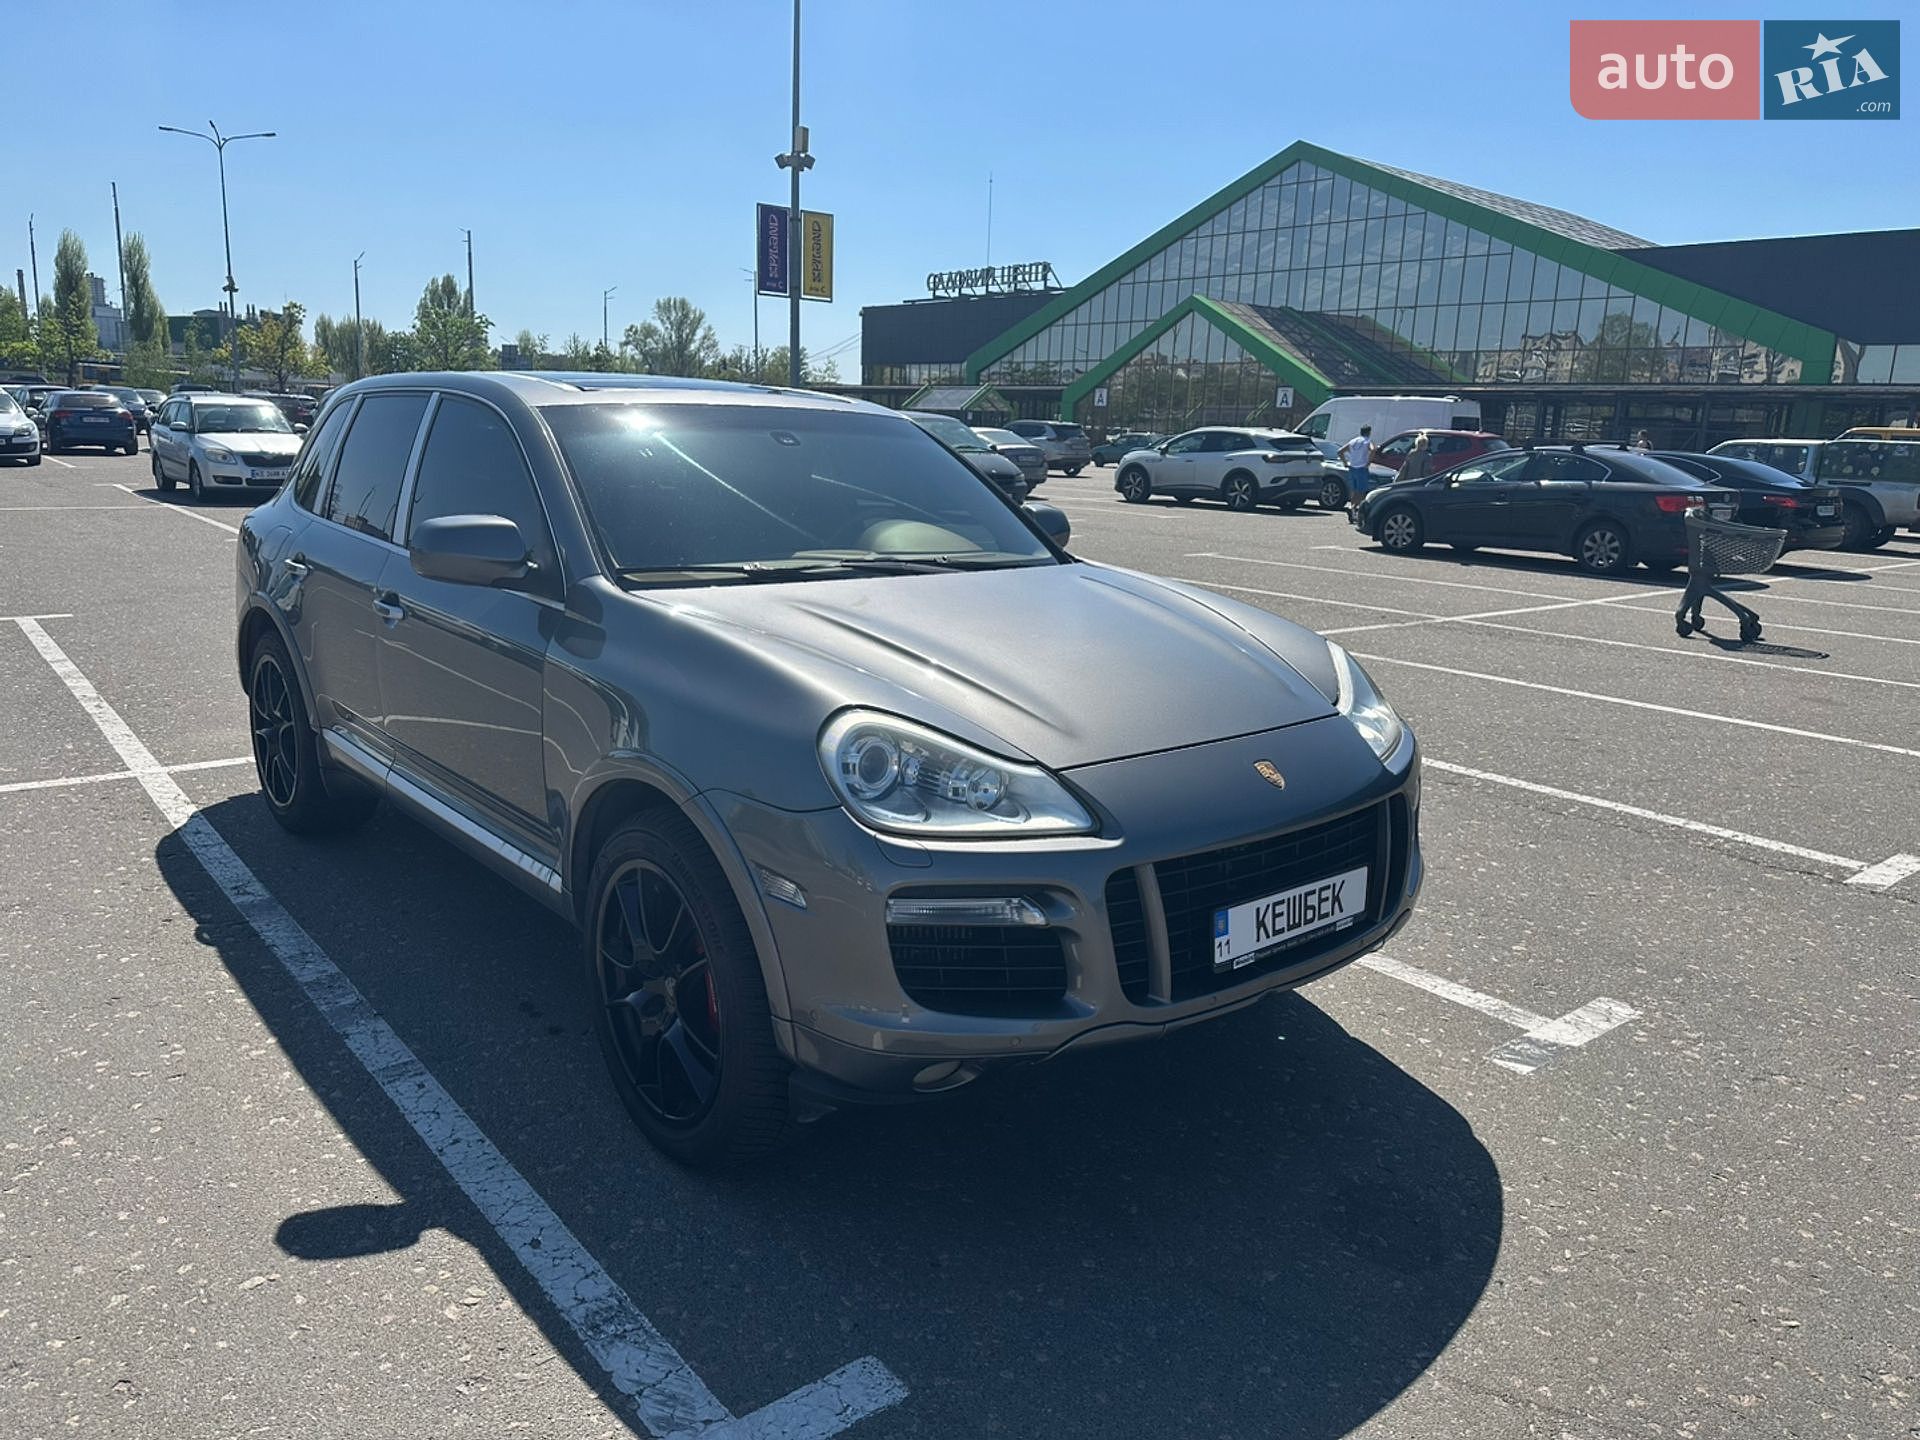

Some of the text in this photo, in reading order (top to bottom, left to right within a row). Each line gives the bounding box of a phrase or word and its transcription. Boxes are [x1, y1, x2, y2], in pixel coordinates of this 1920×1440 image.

[1000, 260, 1052, 288] ЦЕНТР
[1255, 879, 1346, 943] КЕШБЕК
[1216, 938, 1231, 960] 11
